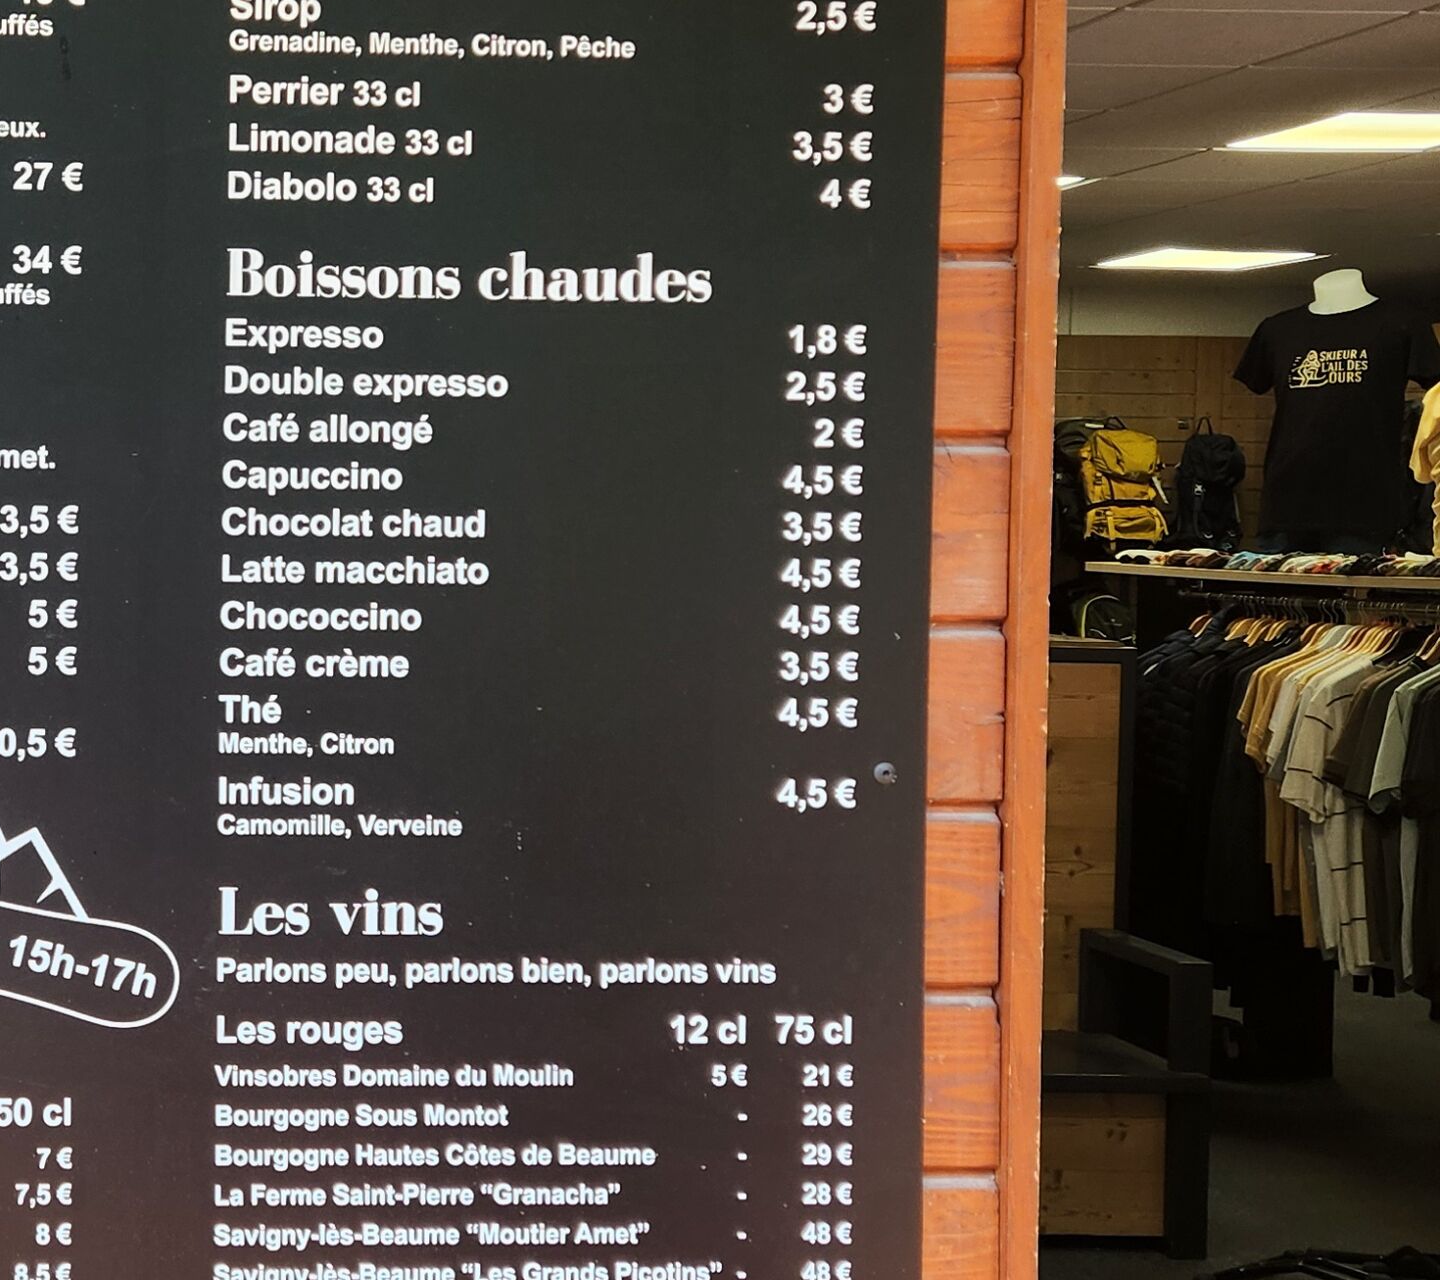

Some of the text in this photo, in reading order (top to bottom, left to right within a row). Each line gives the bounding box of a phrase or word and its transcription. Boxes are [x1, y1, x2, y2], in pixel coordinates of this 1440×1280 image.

[228, 28, 636, 61] Grenadine, Menthe, Citron, Pêche
[226, 247, 713, 304] Boissons chaudes
[224, 317, 384, 355] Expresso
[223, 364, 509, 404] Double expresso
[221, 458, 404, 497] Capuccino
[221, 553, 490, 586] Latte macchiato
[219, 599, 423, 632] Chococcino
[219, 646, 410, 678] Café crème
[218, 775, 355, 806] Infusion
[216, 812, 464, 840] Camomille, Verveine
[217, 886, 444, 937] Les vins
[9, 934, 157, 999] 15h-17h
[215, 956, 777, 990] Parlons peu, parlons bien, parlons vins
[216, 1014, 404, 1052] Les rouges
[669, 1013, 747, 1045] 12 cl
[774, 1013, 853, 1046] 75 cl
[213, 1062, 574, 1088] Vinsobres Domaine du Moulin
[42, 1096, 72, 1127] cl
[214, 1142, 659, 1173] Bourgogne Hautes Côtes de Beaume
